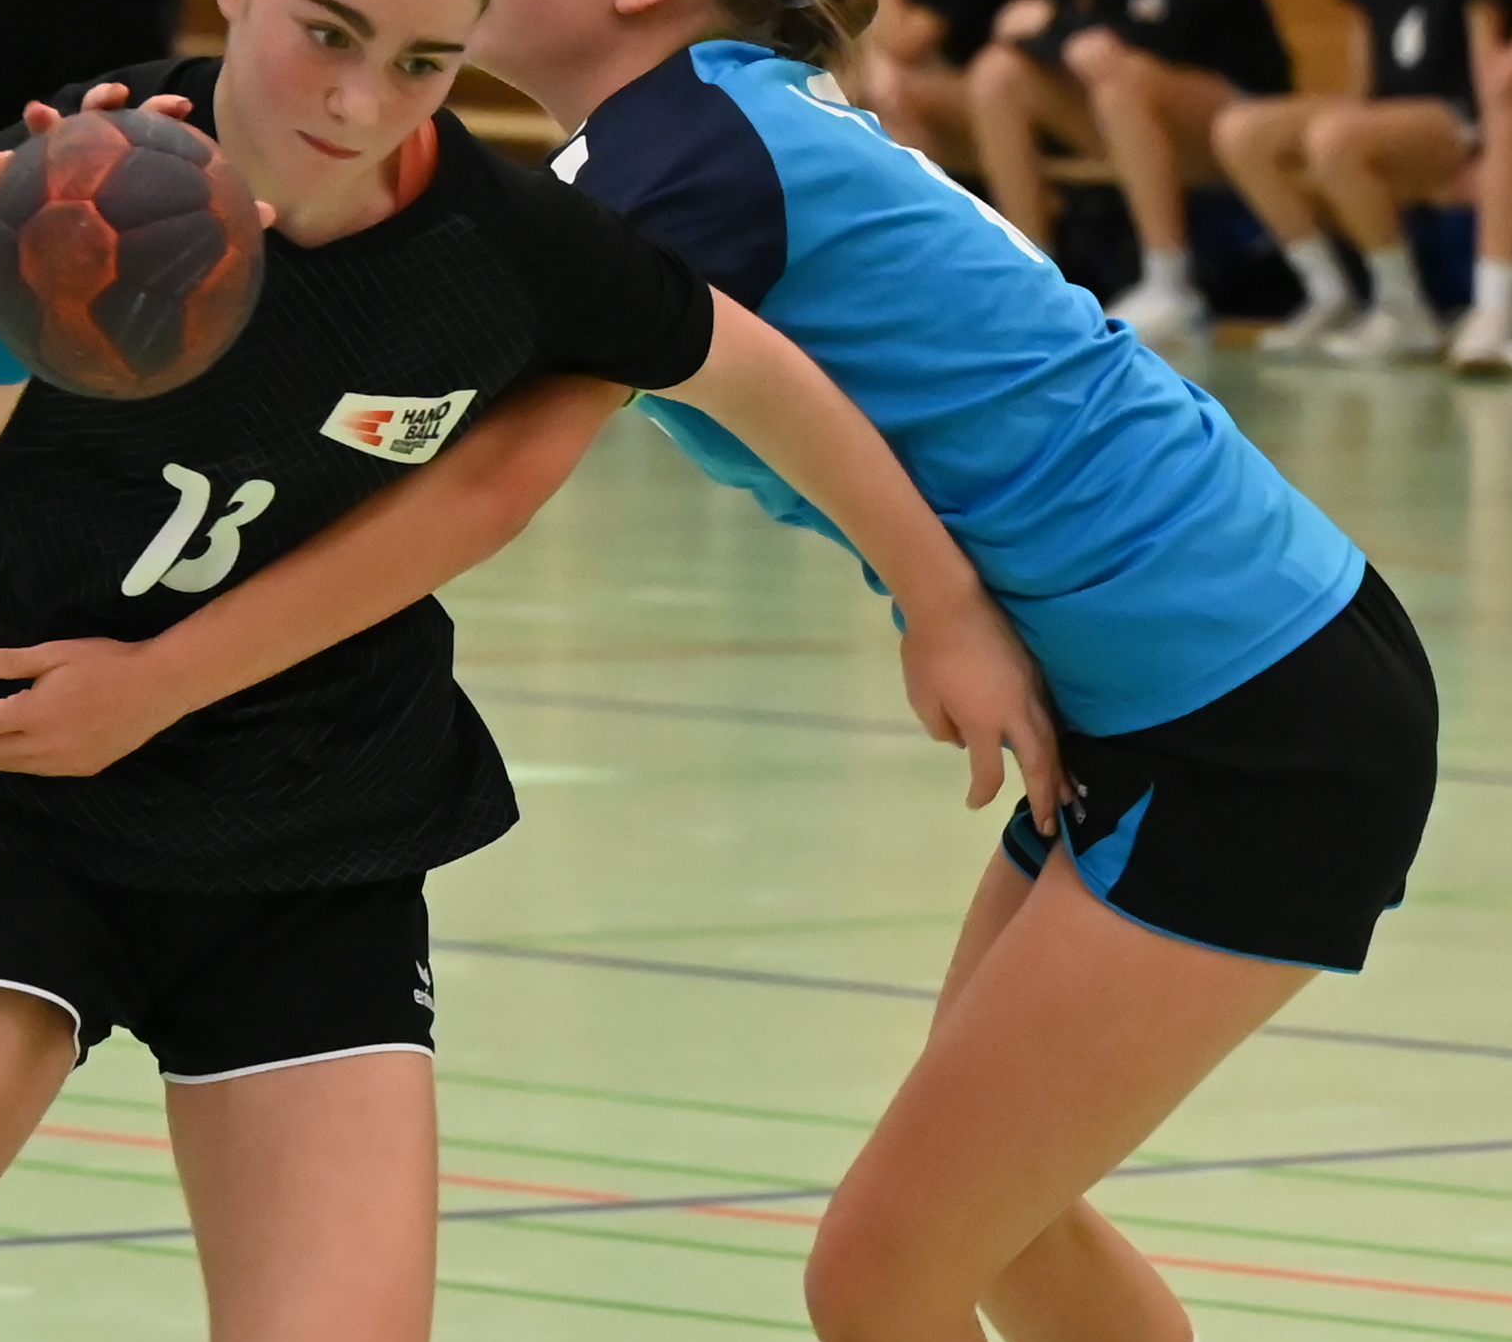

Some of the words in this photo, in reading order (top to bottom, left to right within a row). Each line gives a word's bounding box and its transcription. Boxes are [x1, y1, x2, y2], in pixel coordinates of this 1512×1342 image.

[401, 400, 451, 425] HAND
[404, 421, 441, 440] BALL
[121, 462, 276, 597] 13
